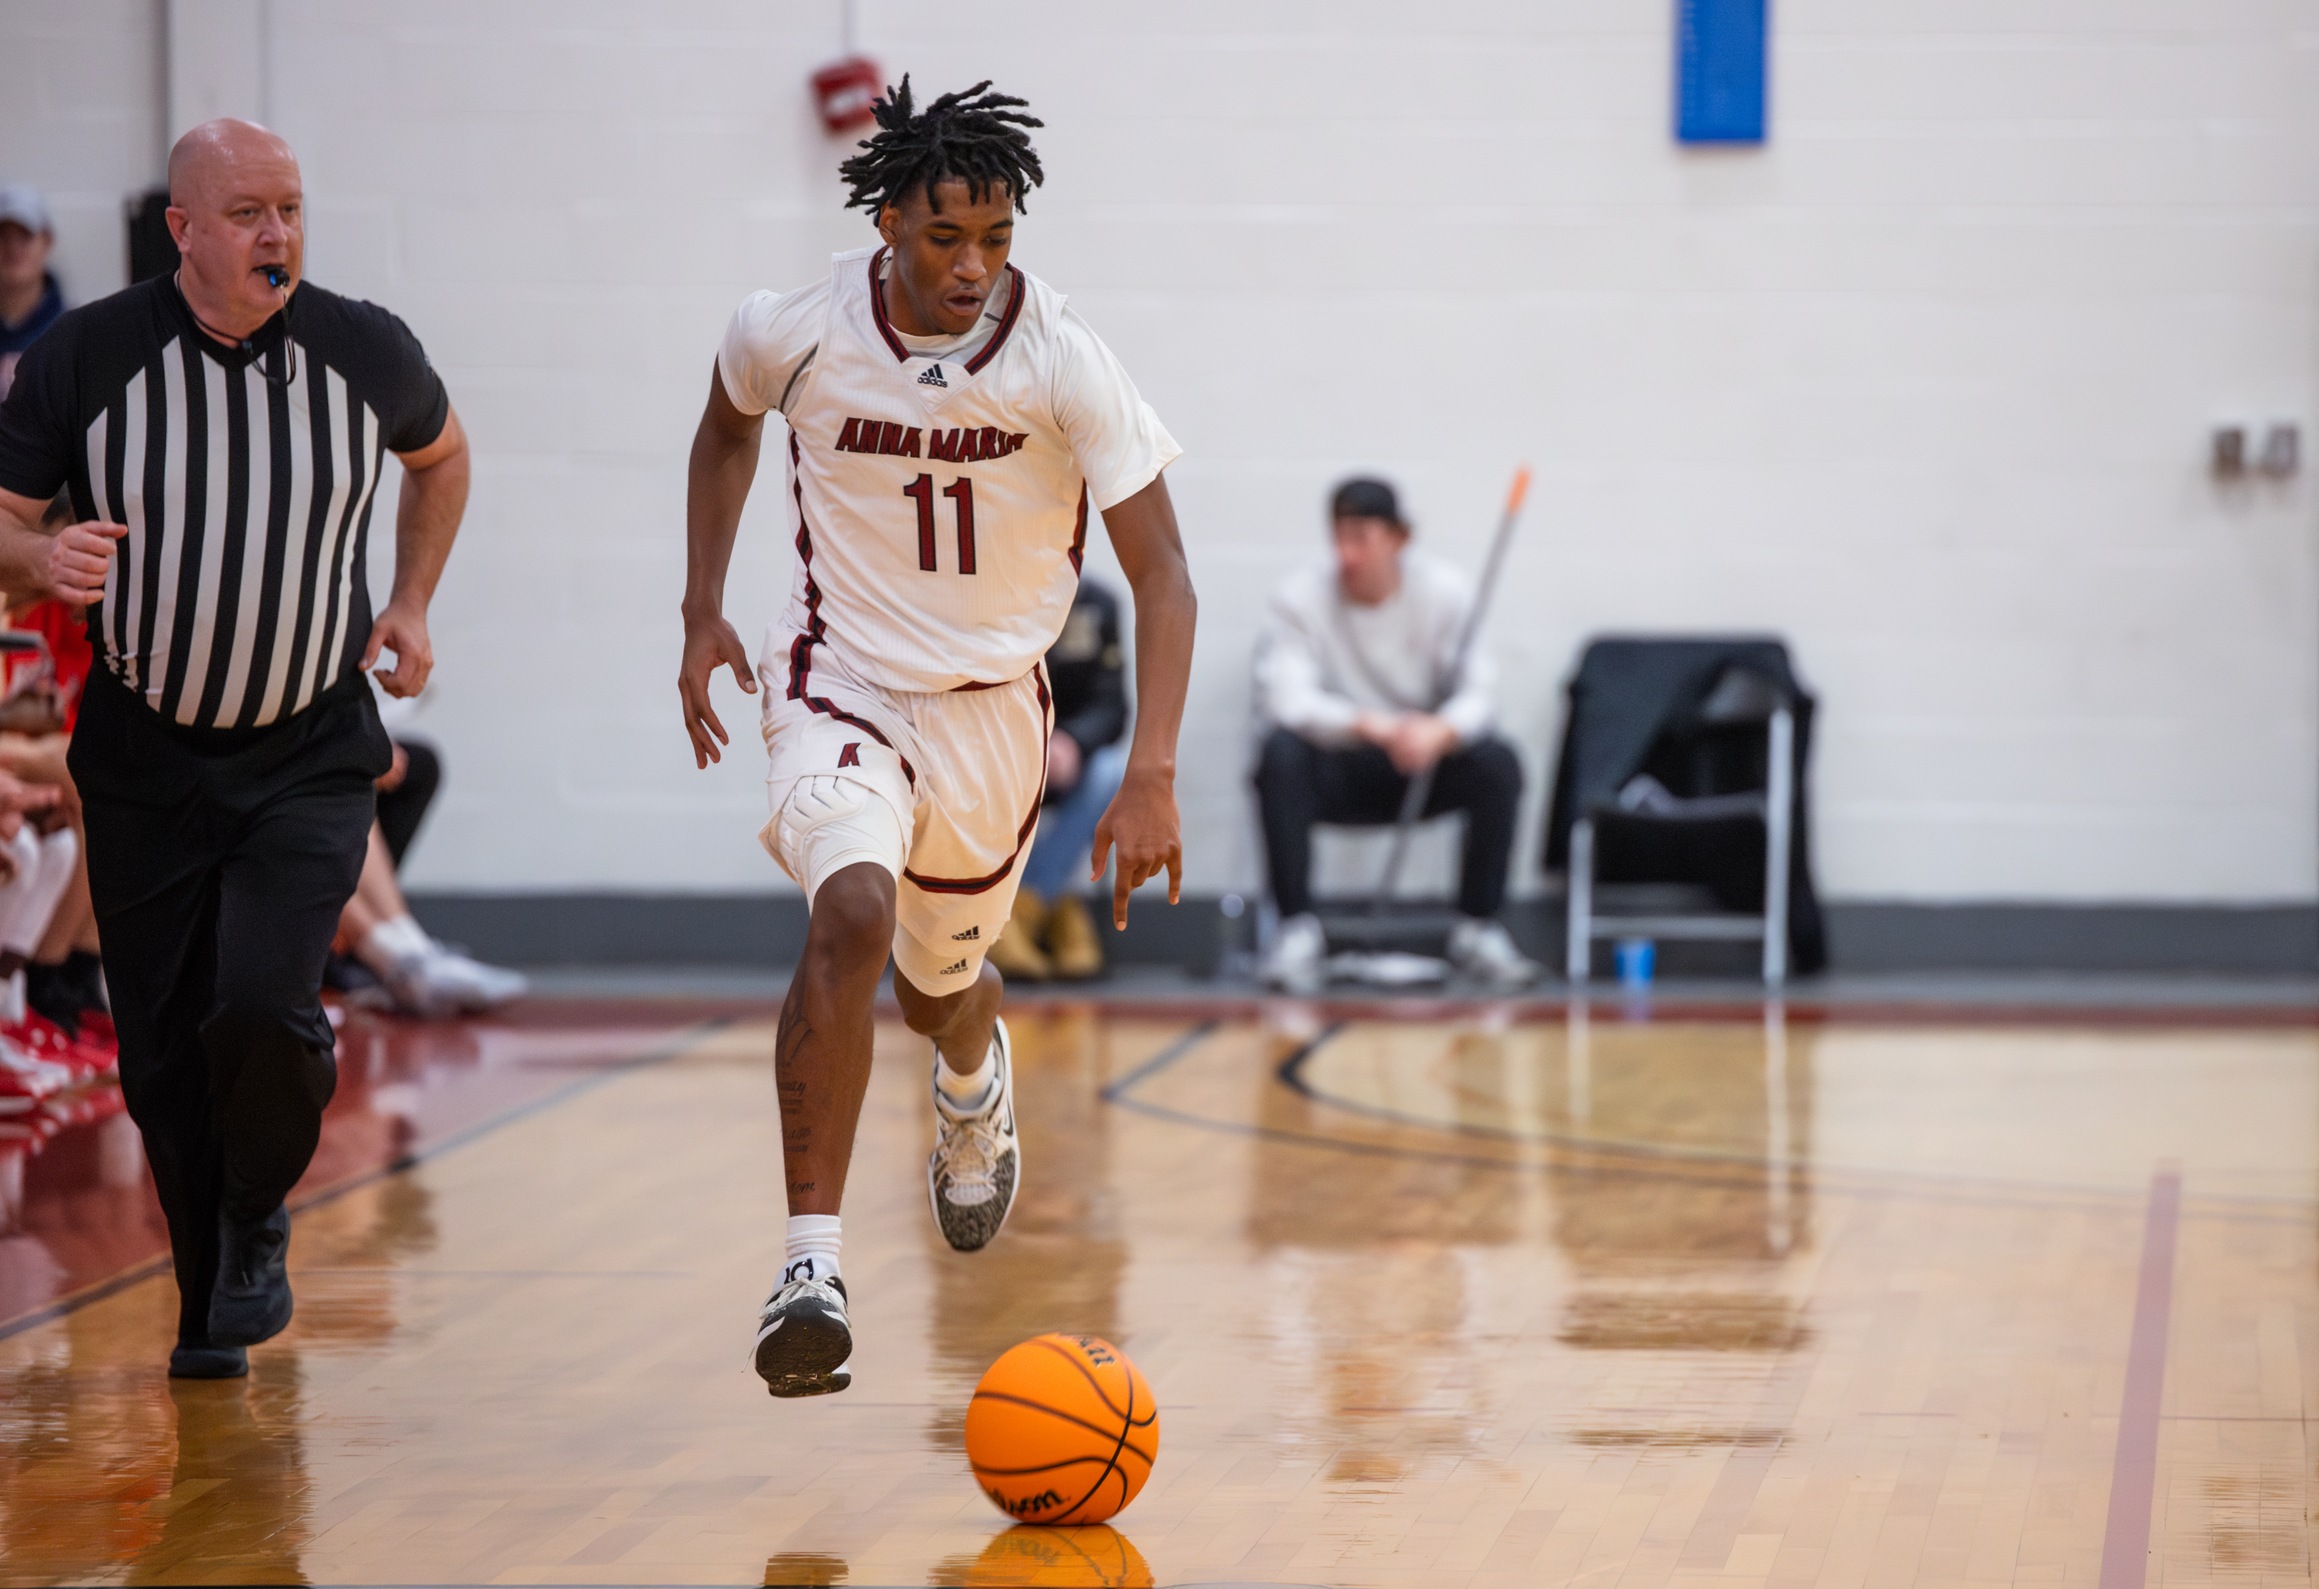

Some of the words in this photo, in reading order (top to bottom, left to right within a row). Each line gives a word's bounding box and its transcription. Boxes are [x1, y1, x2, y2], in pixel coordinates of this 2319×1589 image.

[917, 374, 948, 388] adidas
[835, 417, 923, 458] ANNA
[903, 472, 976, 575] 11
